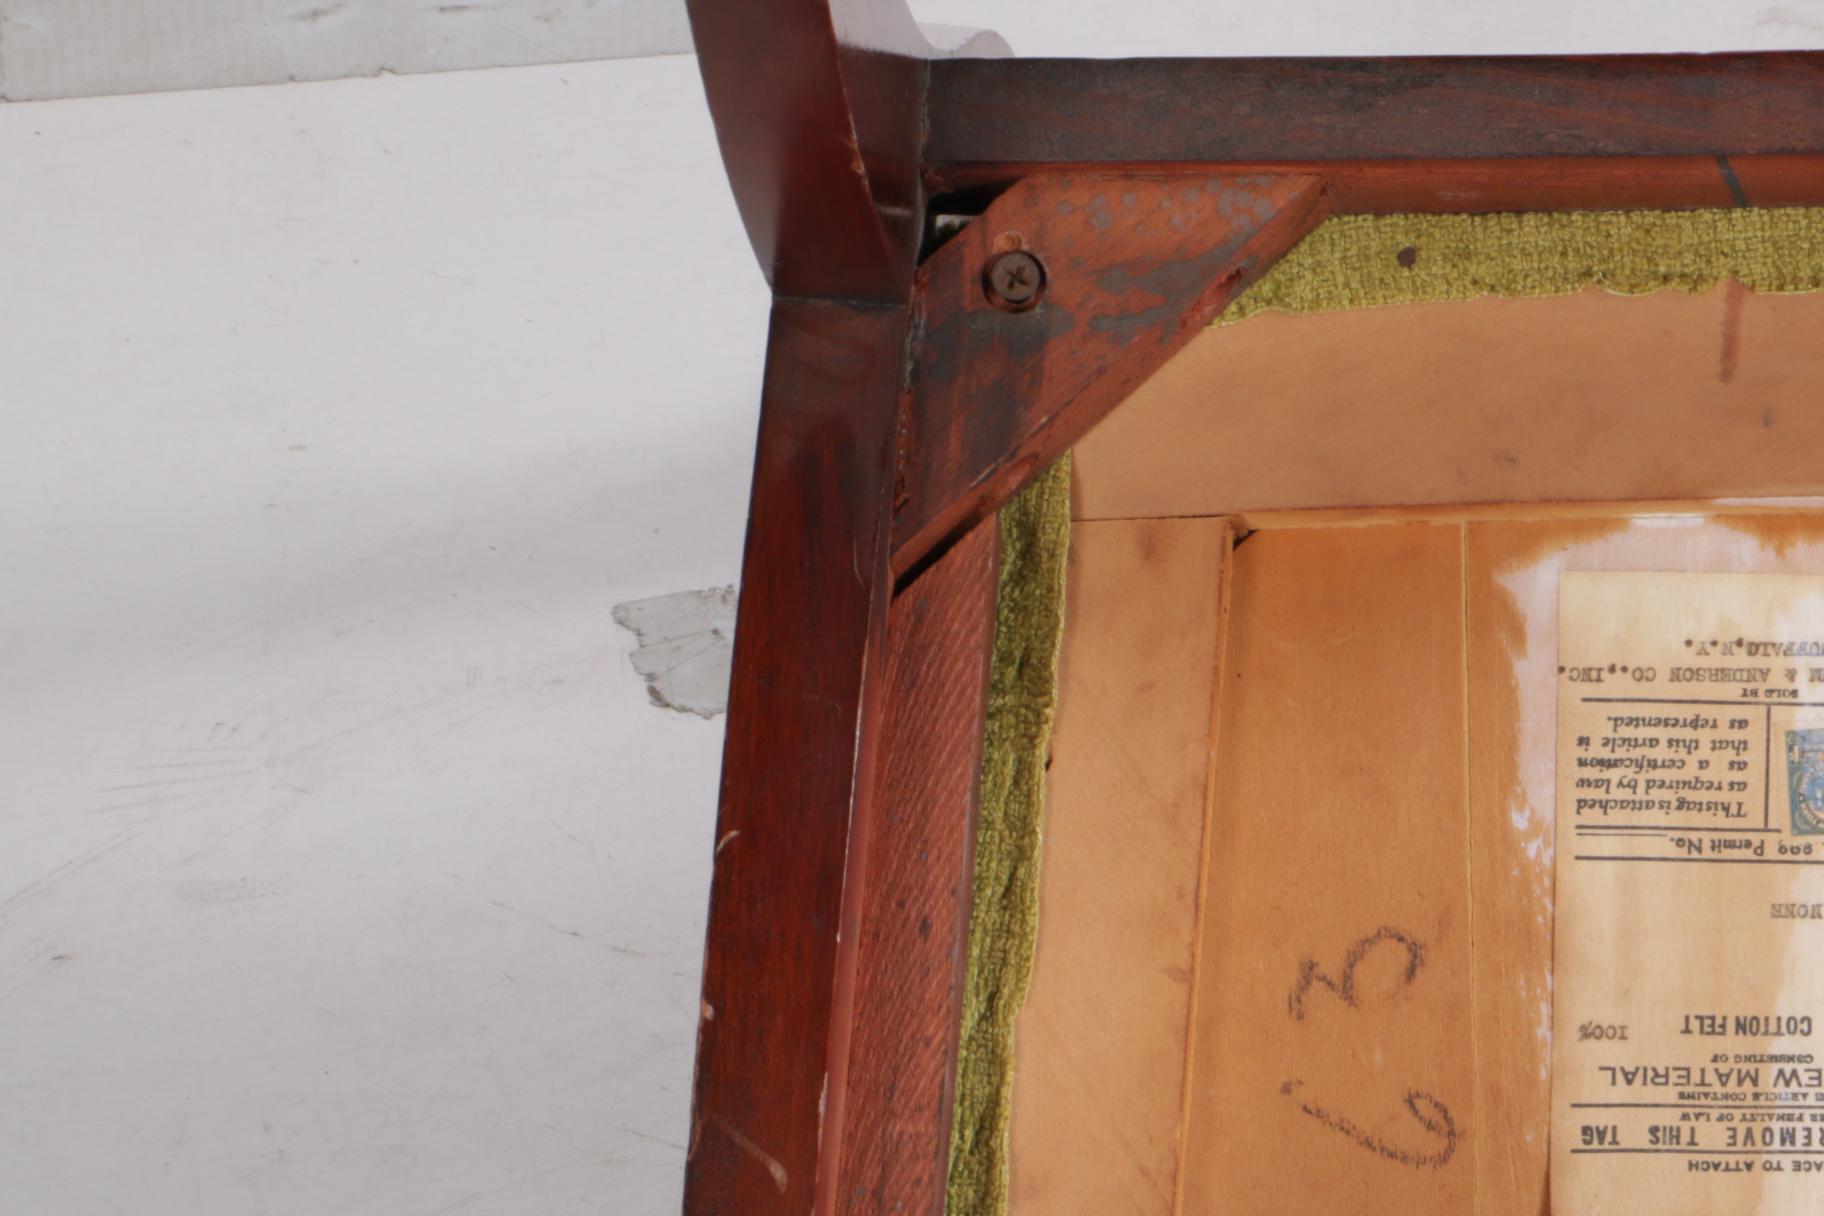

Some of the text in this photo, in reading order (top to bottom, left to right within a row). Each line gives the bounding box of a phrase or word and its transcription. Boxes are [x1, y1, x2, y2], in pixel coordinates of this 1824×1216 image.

[1669, 667, 1771, 682] ANDERSON
[1784, 668, 1798, 681] &
[1741, 688, 1759, 697] BY
[1606, 714, 1749, 733] as represented.
[1576, 735, 1749, 753] that this article is
[1576, 753, 1748, 773] as a certification
[1575, 774, 1748, 794] as required by law
[1575, 796, 1748, 818] This tag is attached
[1669, 838, 1702, 856] No.
[1709, 839, 1765, 856] Permit
[1770, 903, 1824, 920] NONE
[1680, 1014, 1812, 1035] COTTON FELT
[1710, 1053, 1729, 1063] OF
[1598, 1065, 1760, 1087] MATERIAL
[1752, 1091, 1809, 1101] ARTICLE
[1679, 1112, 1711, 1122] LAW
[1715, 1112, 1734, 1122] OF
[1739, 1112, 1804, 1122] PENALTY
[1580, 1125, 1620, 1146] TAG
[1648, 1125, 1699, 1146] THIS
[1688, 1159, 1754, 1172] ATTACH
[1762, 1160, 1783, 1172] TO
